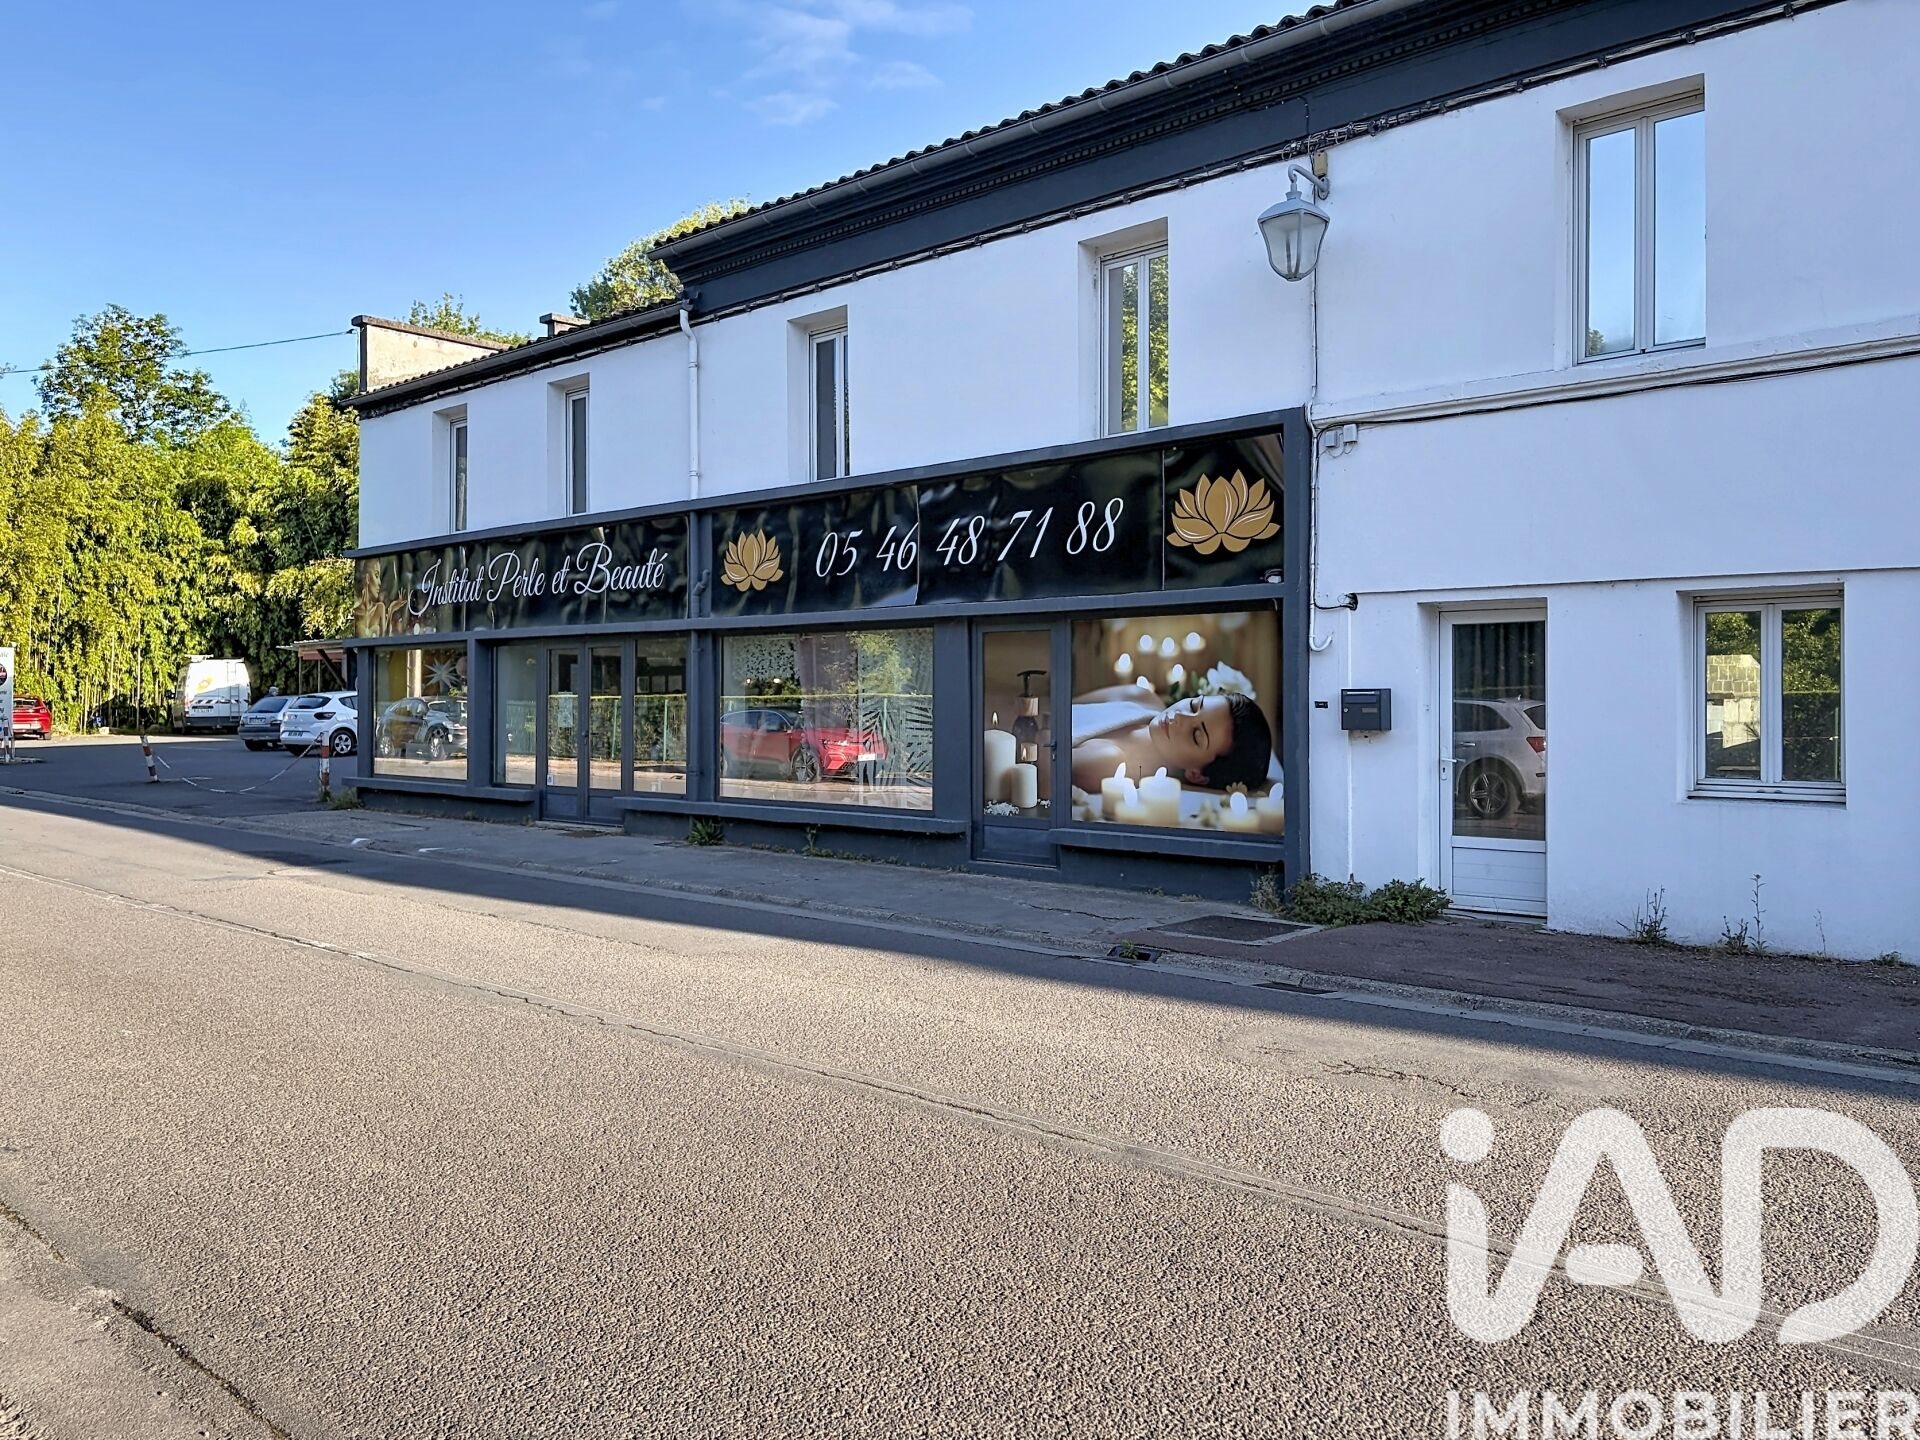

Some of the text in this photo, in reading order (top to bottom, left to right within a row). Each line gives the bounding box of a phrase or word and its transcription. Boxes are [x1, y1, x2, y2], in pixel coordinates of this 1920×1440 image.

[815, 497, 1124, 577] 05 46 48 71 88
[408, 543, 668, 616] Institut Perle et Beauté
